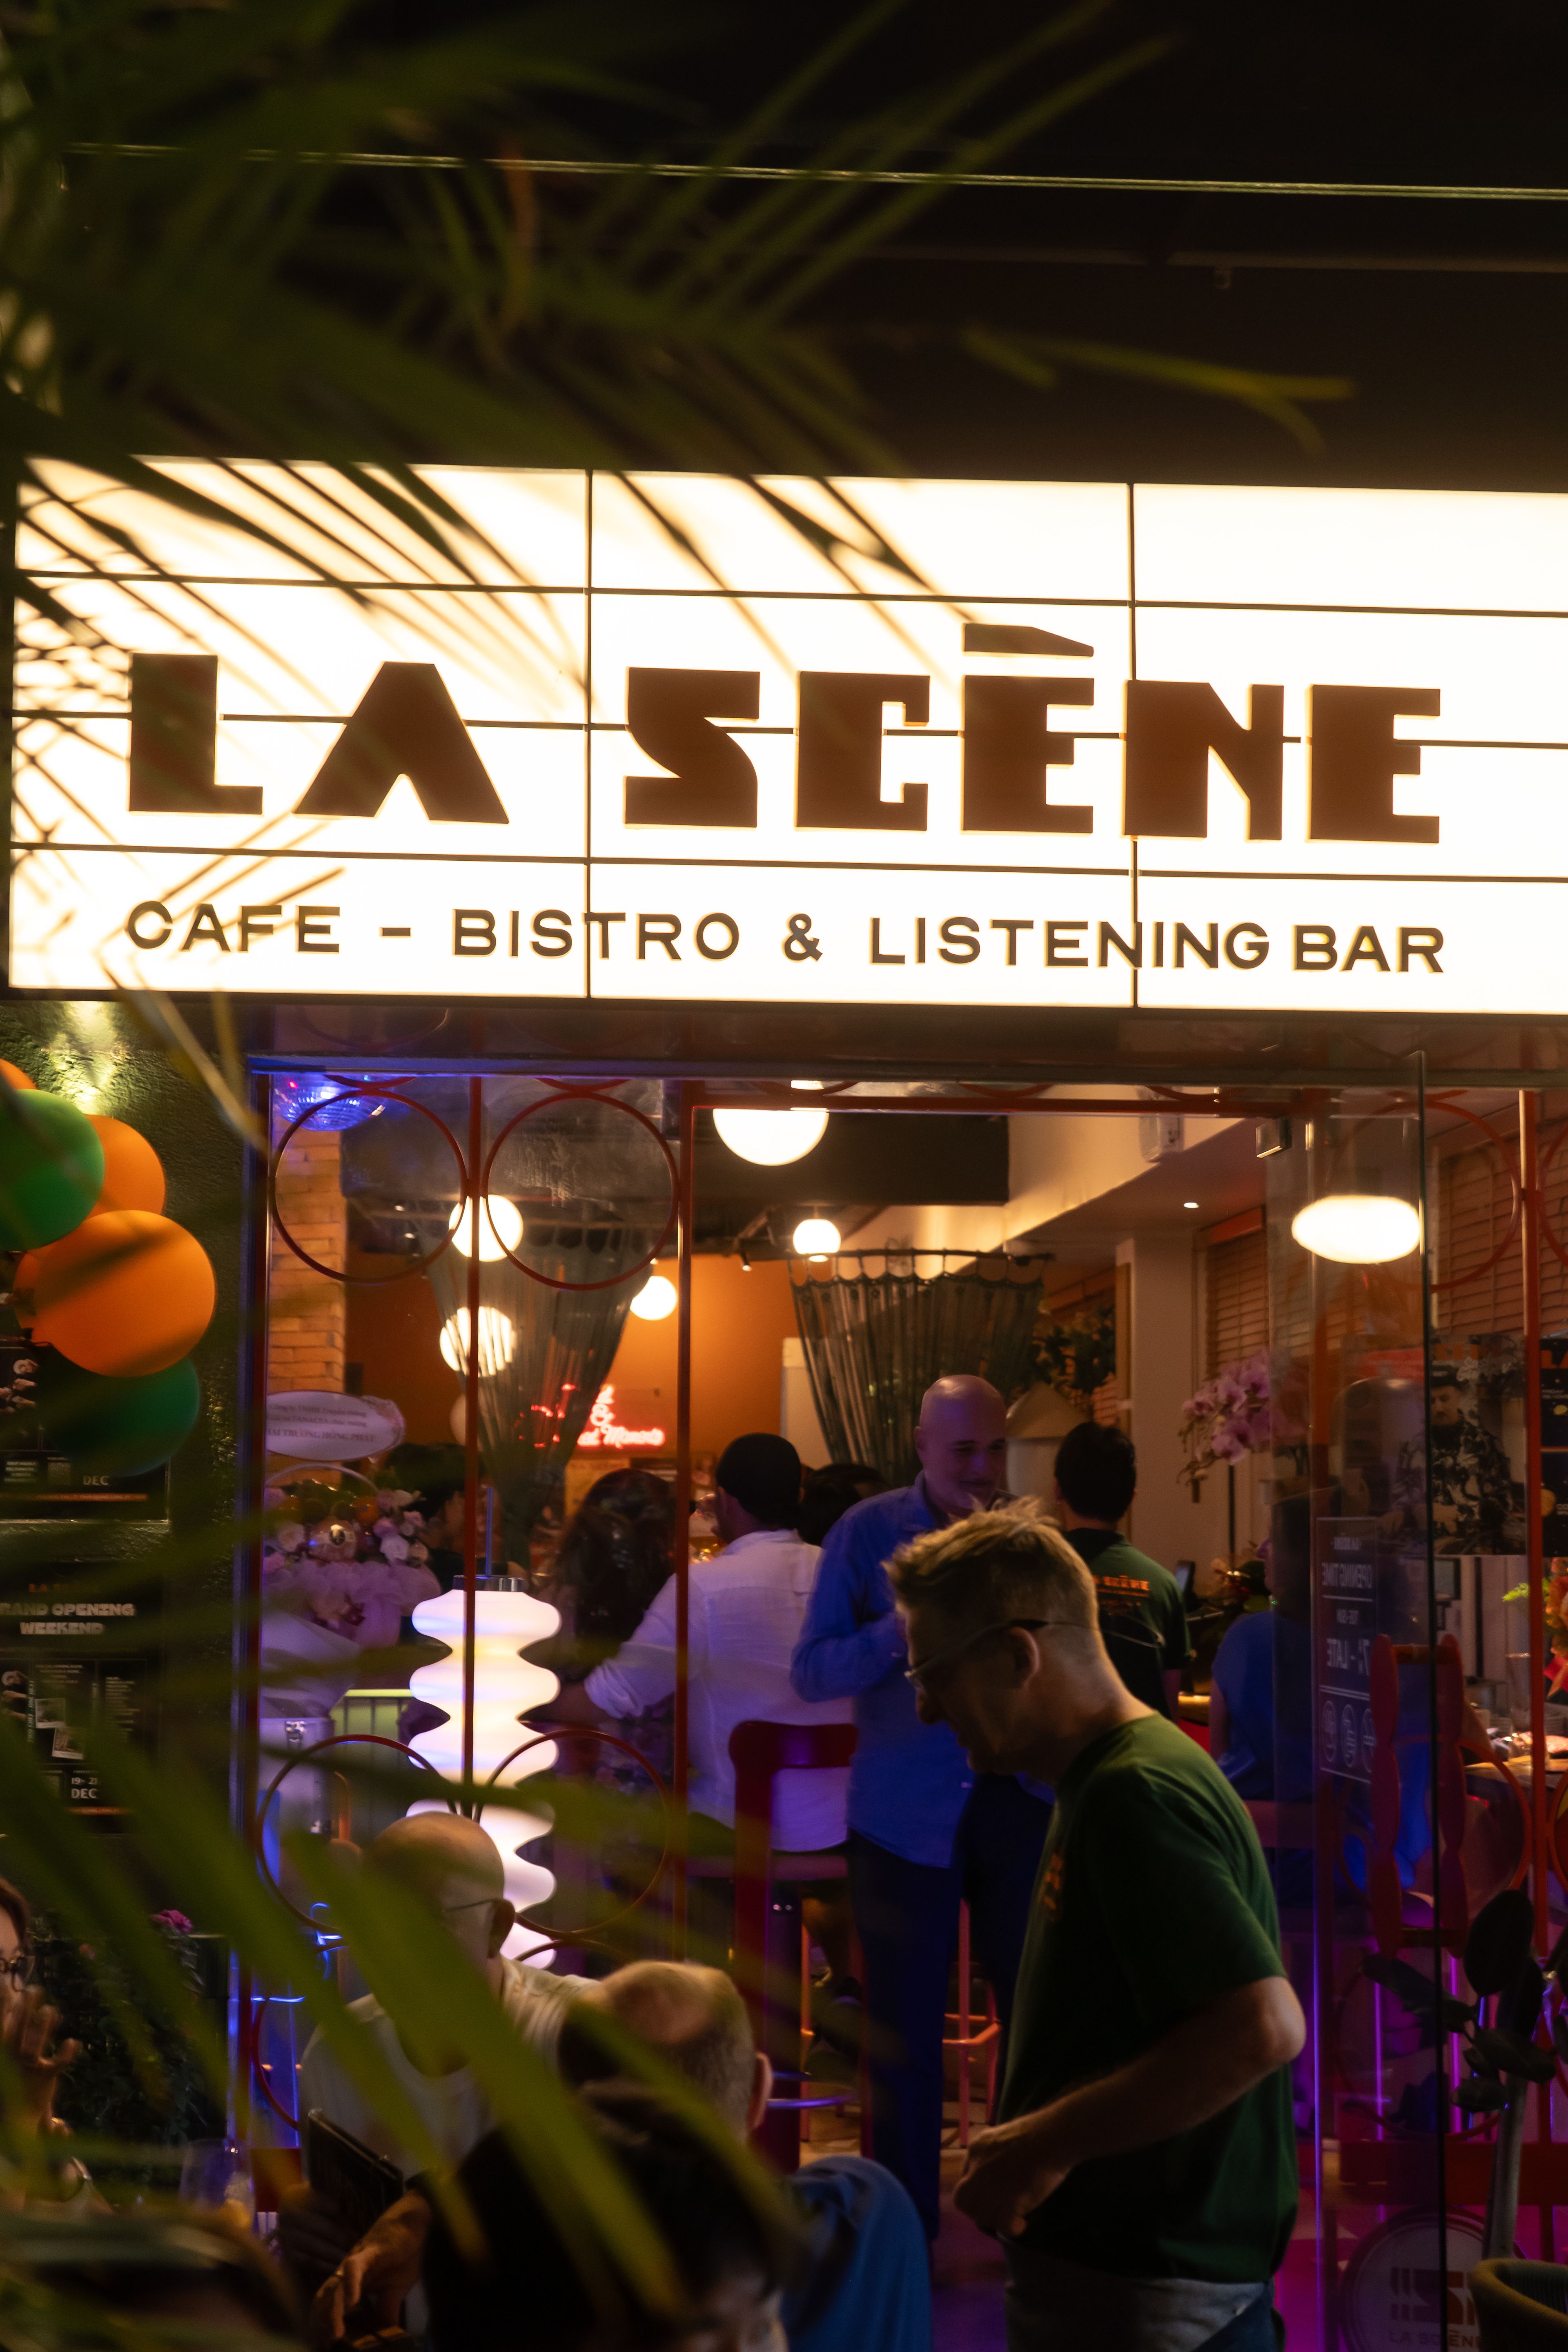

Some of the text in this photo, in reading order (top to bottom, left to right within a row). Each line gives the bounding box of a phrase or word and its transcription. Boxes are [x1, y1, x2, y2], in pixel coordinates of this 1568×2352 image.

[129, 622, 1441, 844] LA SCÈNE
[125, 900, 340, 953] CAFE
[453, 908, 740, 960] BISTRO
[783, 913, 823, 962] &
[870, 916, 1270, 969] LISTENING
[1293, 924, 1445, 973] BAR
[82, 1475, 109, 1486] DEC
[0, 1602, 136, 1617] RAND OPENING
[20, 1621, 105, 1635] WEEKEND
[71, 1788, 98, 1800] DEC
